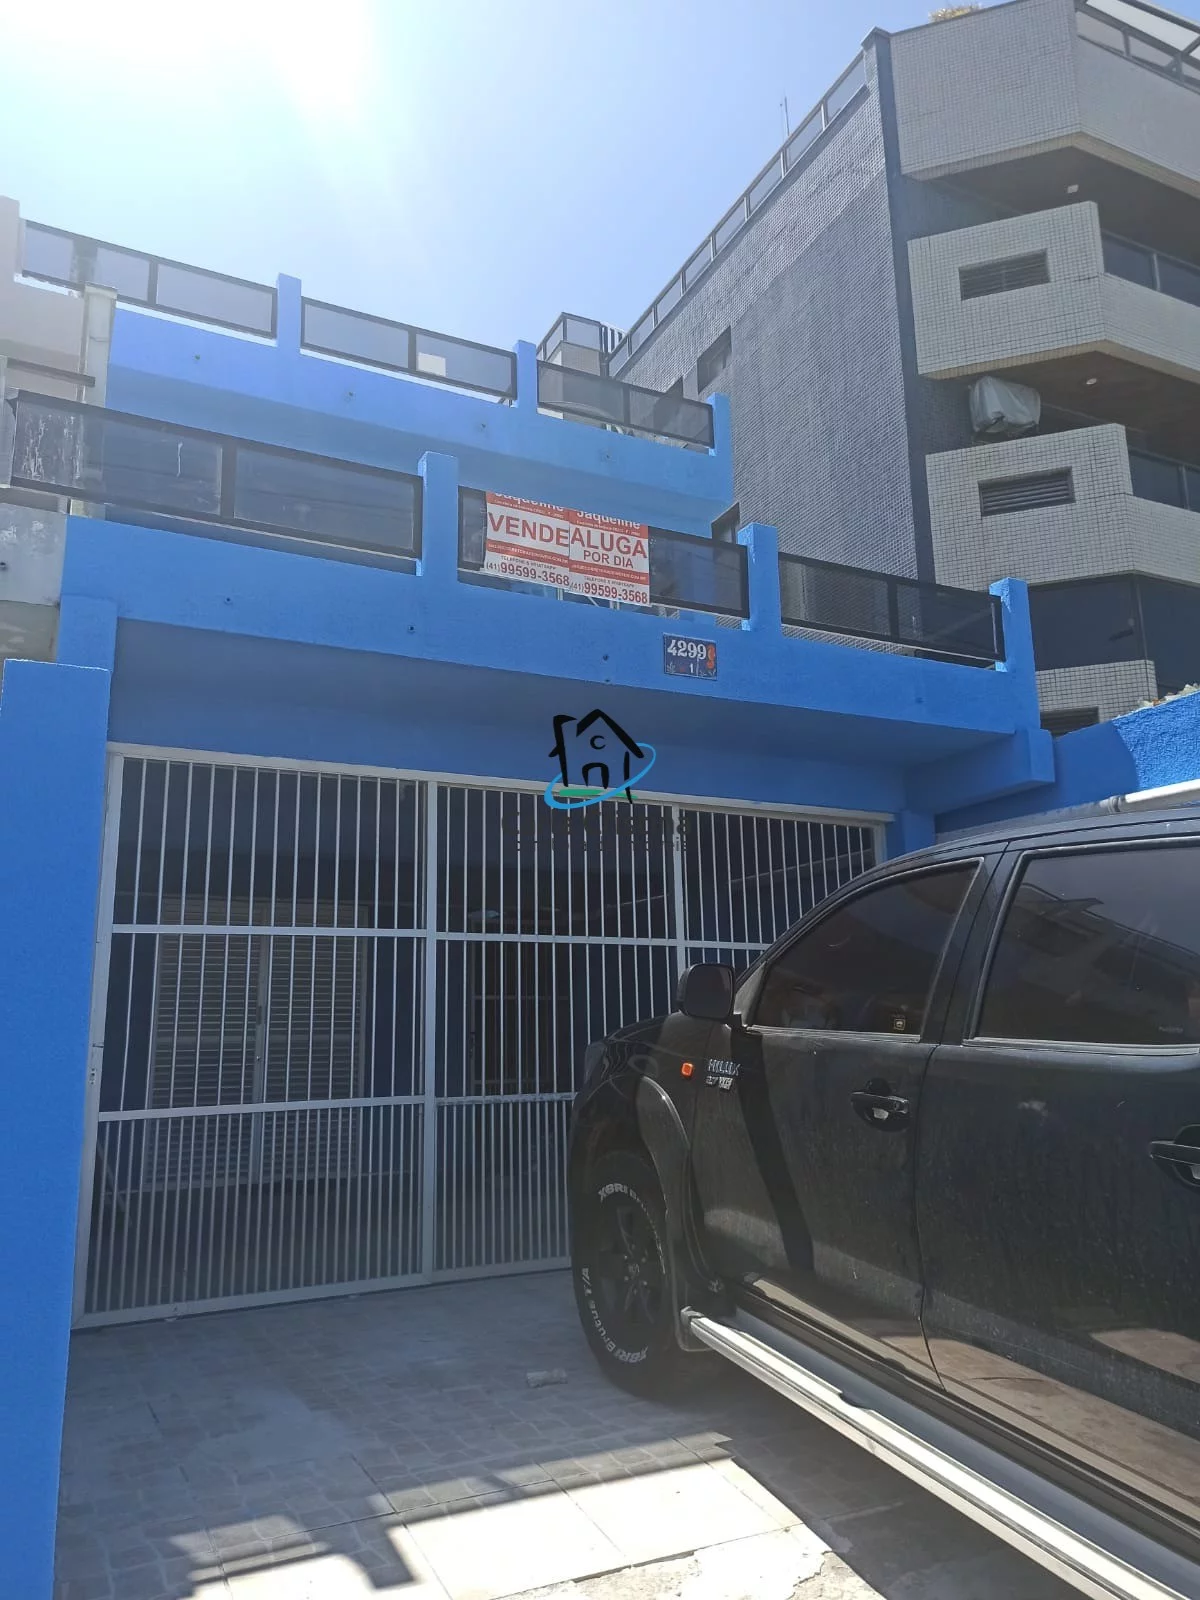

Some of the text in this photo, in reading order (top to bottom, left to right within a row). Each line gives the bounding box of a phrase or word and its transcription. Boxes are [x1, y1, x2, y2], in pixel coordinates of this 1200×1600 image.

[488, 511, 569, 547] VENDE
[570, 527, 647, 558] ALUGA
[583, 549, 610, 564] POR
[613, 555, 634, 568] DIA
[667, 639, 707, 660] 4299
